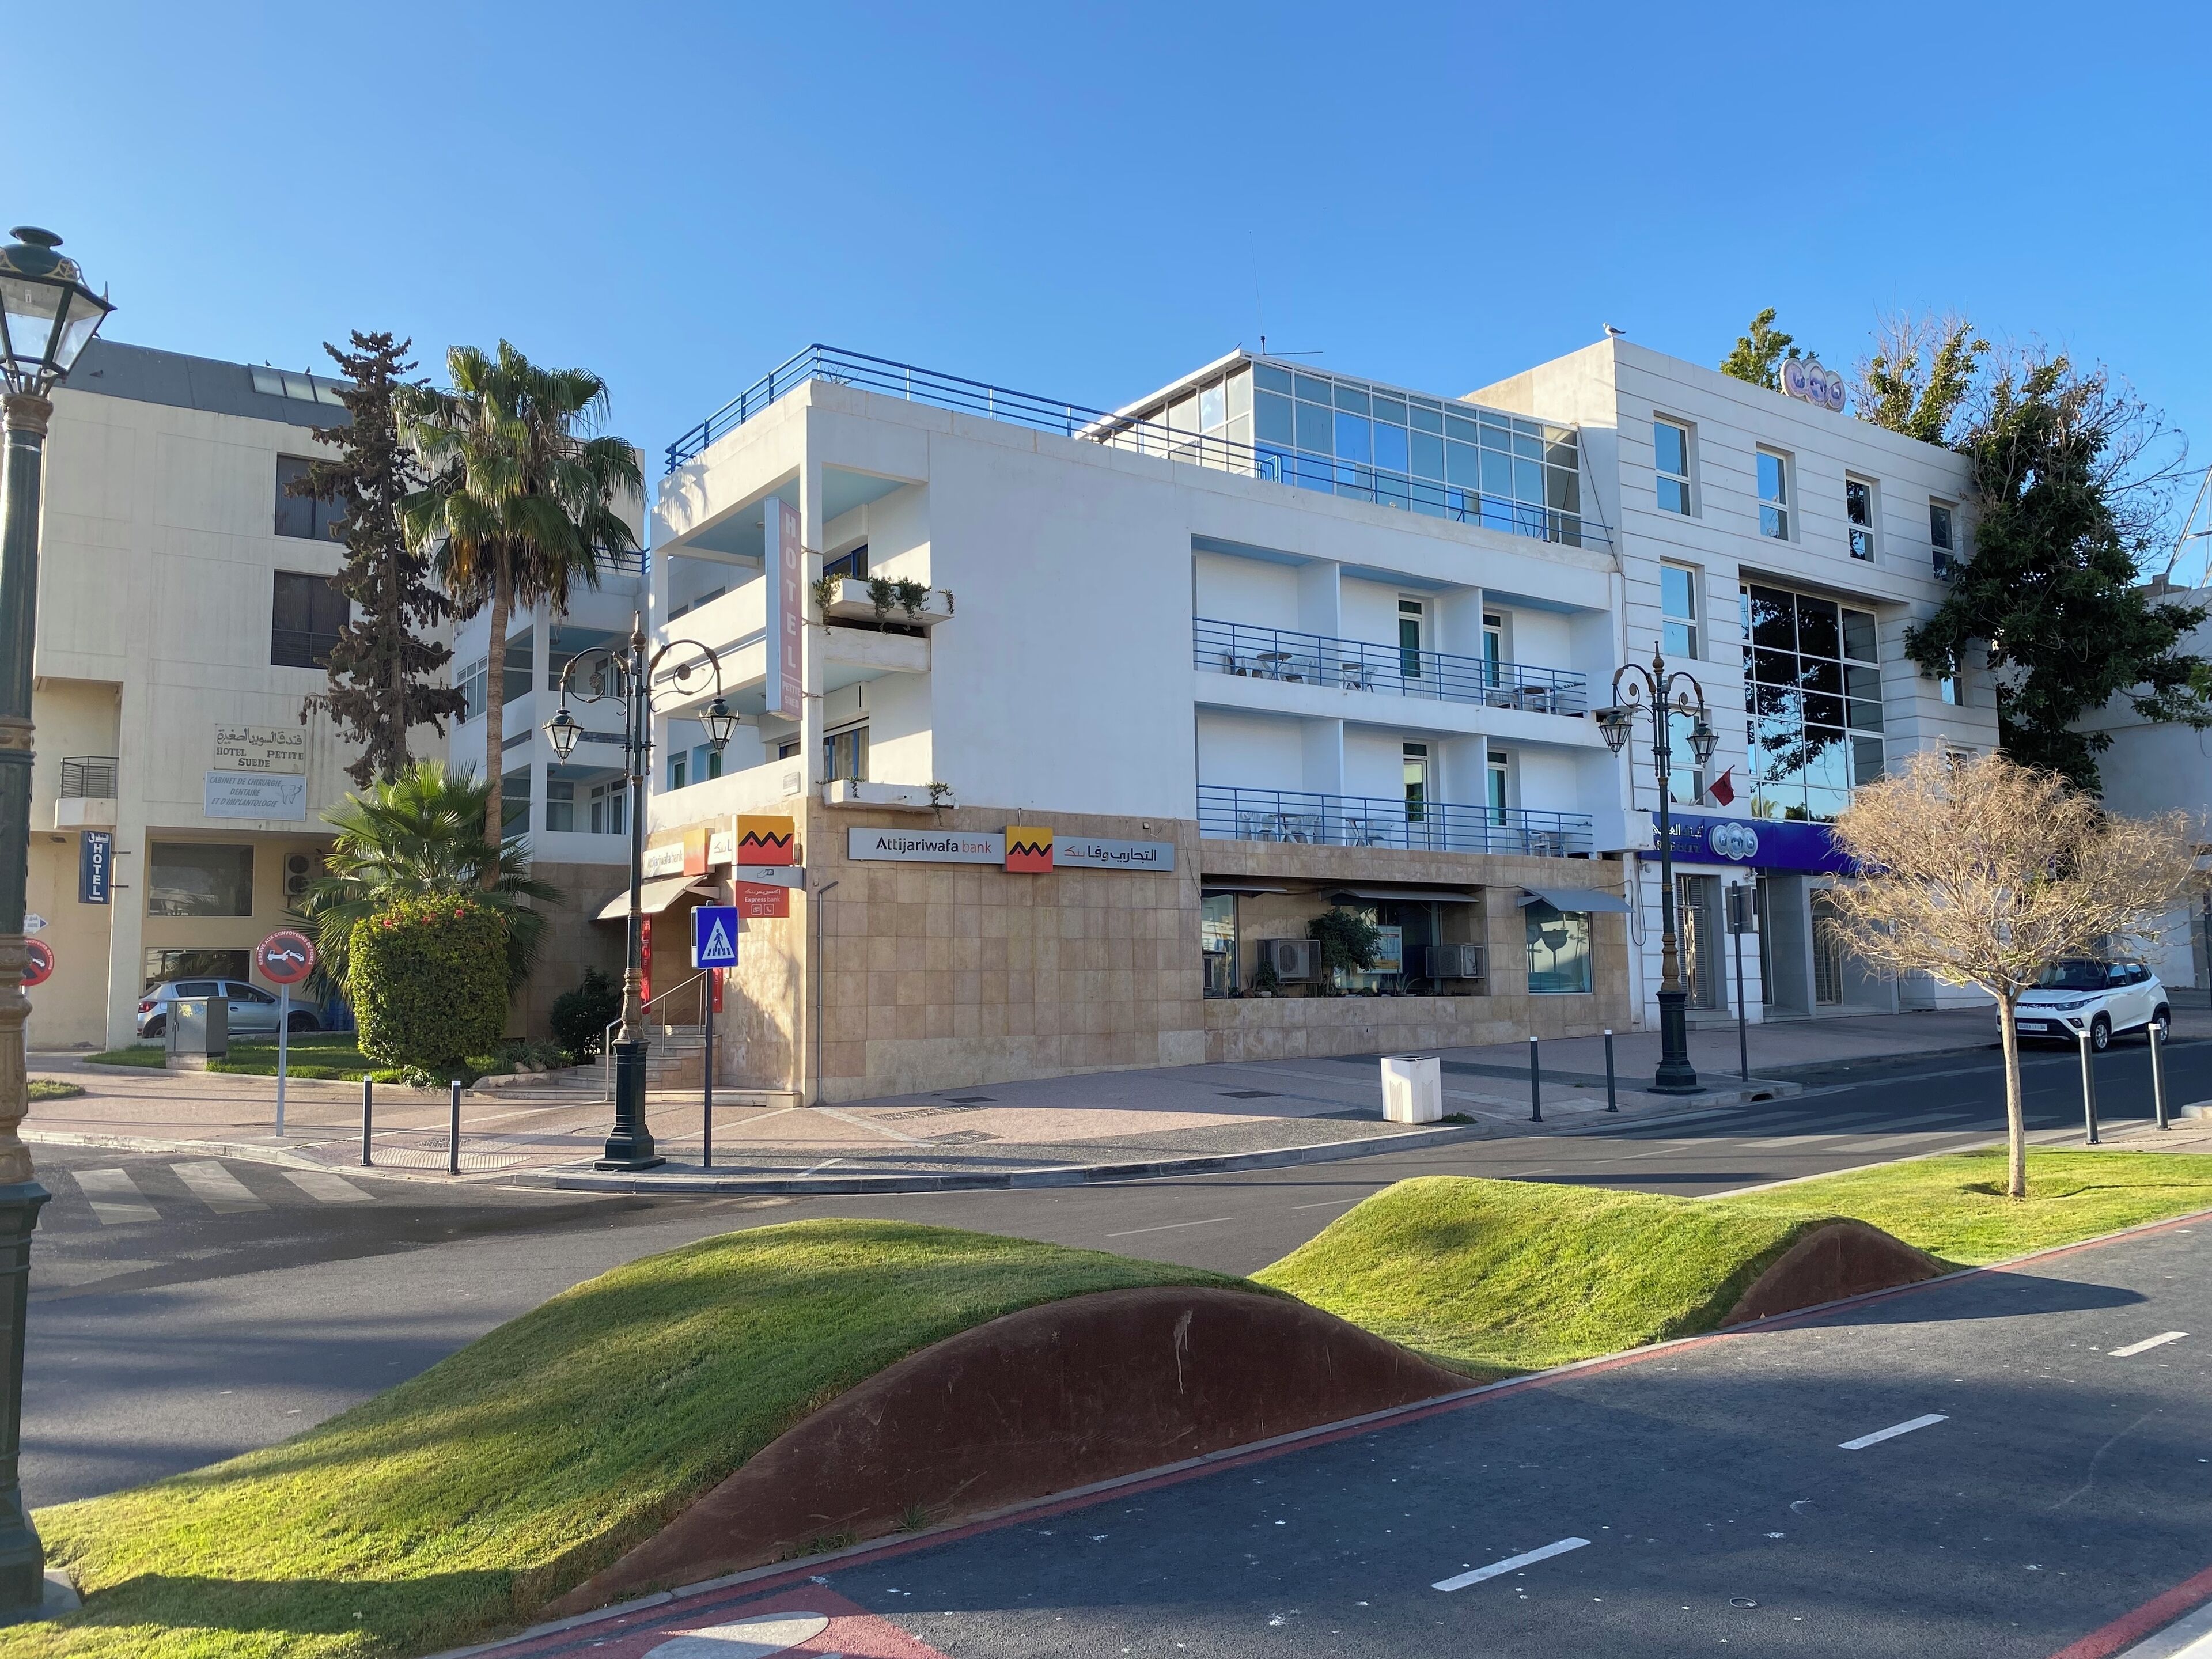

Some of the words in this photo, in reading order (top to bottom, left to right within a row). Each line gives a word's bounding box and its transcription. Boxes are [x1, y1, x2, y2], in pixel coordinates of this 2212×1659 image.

[785, 512, 796, 669] HOTEL
[782, 680, 802, 696] PETITE
[216, 747, 247, 756] HOTEL
[267, 750, 304, 760] PETITE
[238, 758, 270, 767] SUEDE
[209, 776, 237, 785] CABINET
[247, 778, 282, 787] CHIRURGIE
[229, 788, 261, 796] DENTAIRE
[220, 798, 279, 808] D'IMPLANTOLOGIE
[876, 836, 959, 854] Attijariwafa
[961, 839, 992, 854] bank
[671, 849, 683, 863] bank
[92, 843, 103, 896] HOTEL
[264, 935, 275, 944] AUX
[274, 931, 308, 942] CONVOYEURS
